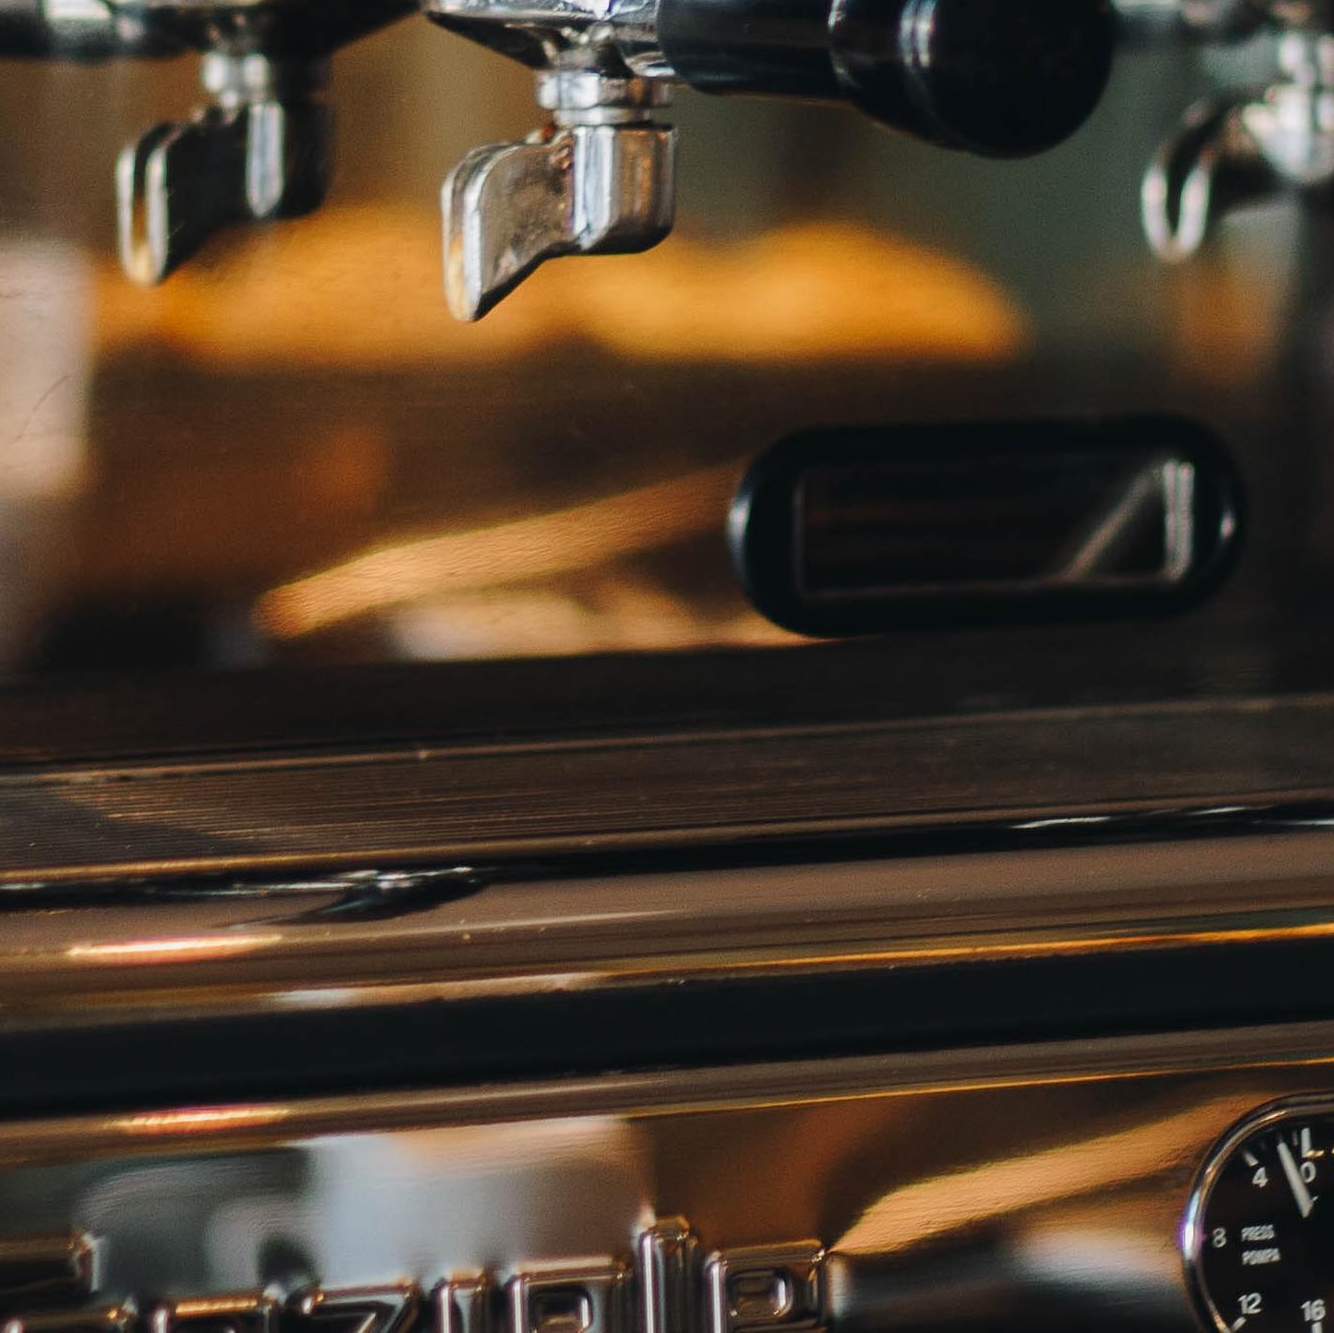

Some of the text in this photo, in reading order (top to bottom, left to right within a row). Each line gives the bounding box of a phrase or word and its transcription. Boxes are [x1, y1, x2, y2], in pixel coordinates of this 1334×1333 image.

[1251, 1166, 1270, 1189] 4
[1300, 1161, 1317, 1184] 0
[1212, 1227, 1227, 1248] 8
[1238, 1292, 1262, 1315] 12
[1300, 1298, 1327, 1322] 16
